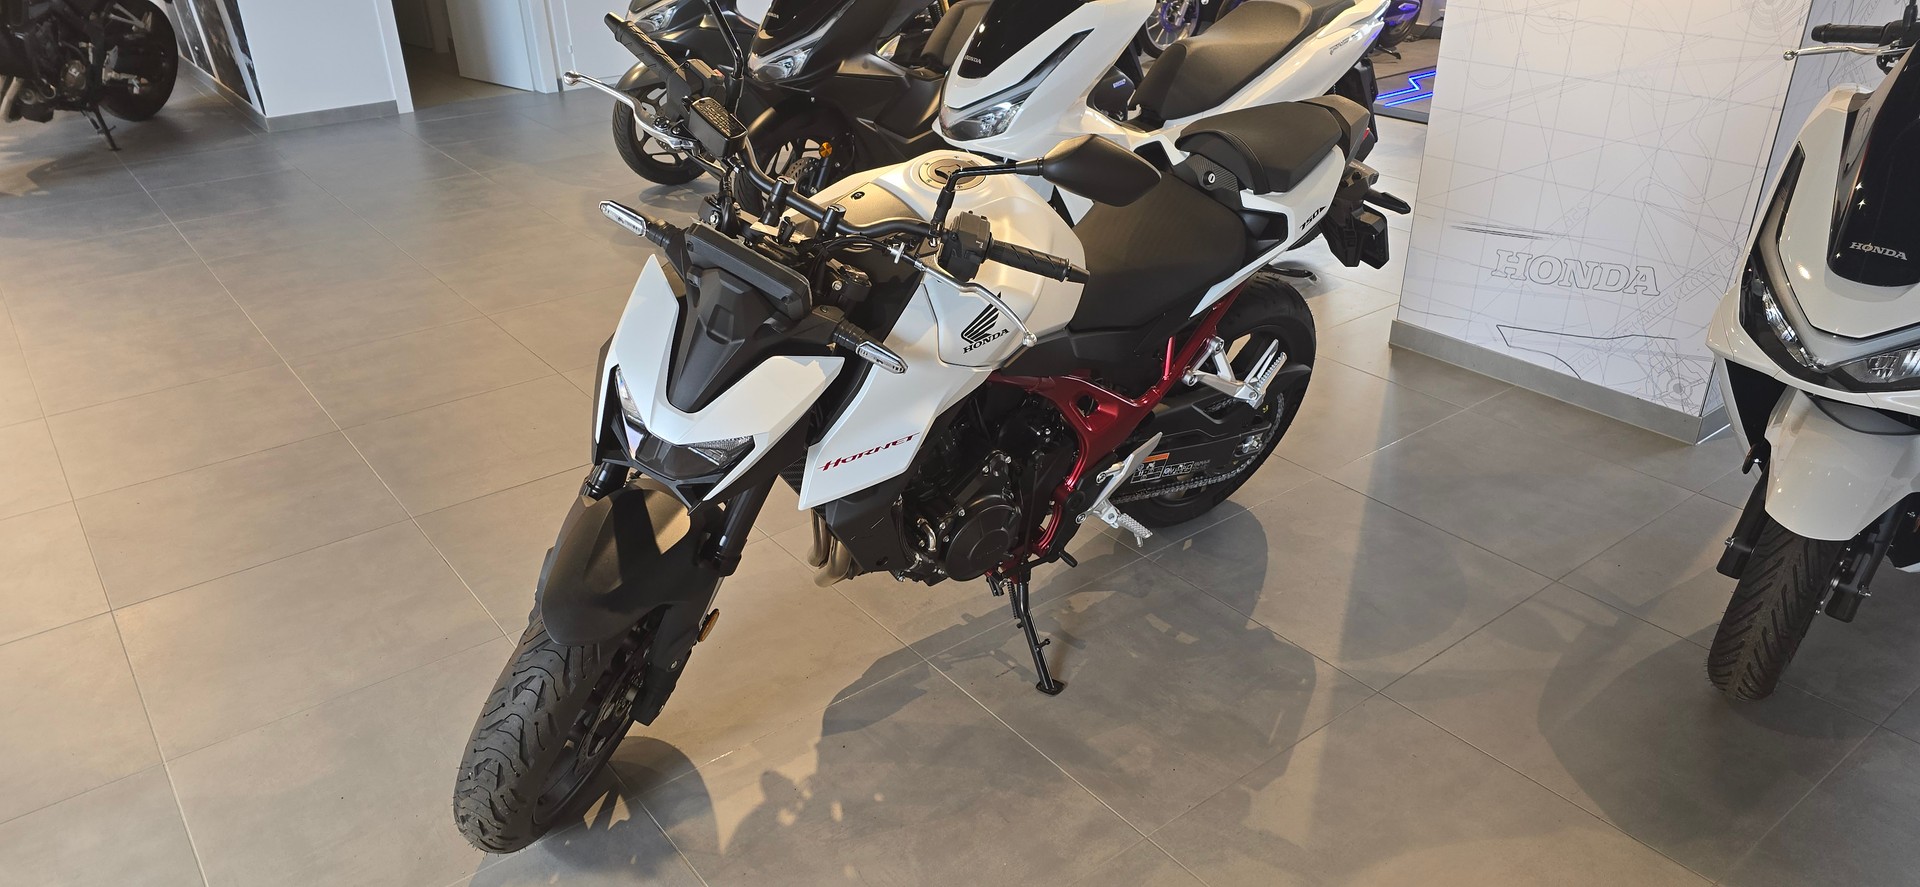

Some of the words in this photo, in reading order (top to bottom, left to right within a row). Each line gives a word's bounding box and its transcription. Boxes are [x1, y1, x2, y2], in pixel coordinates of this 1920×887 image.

[1299, 208, 1320, 231] 750
[1849, 241, 1908, 261] HONDA
[1491, 248, 1661, 296] HONDA
[962, 328, 1010, 354] HONDA
[817, 431, 921, 472] HORNET
